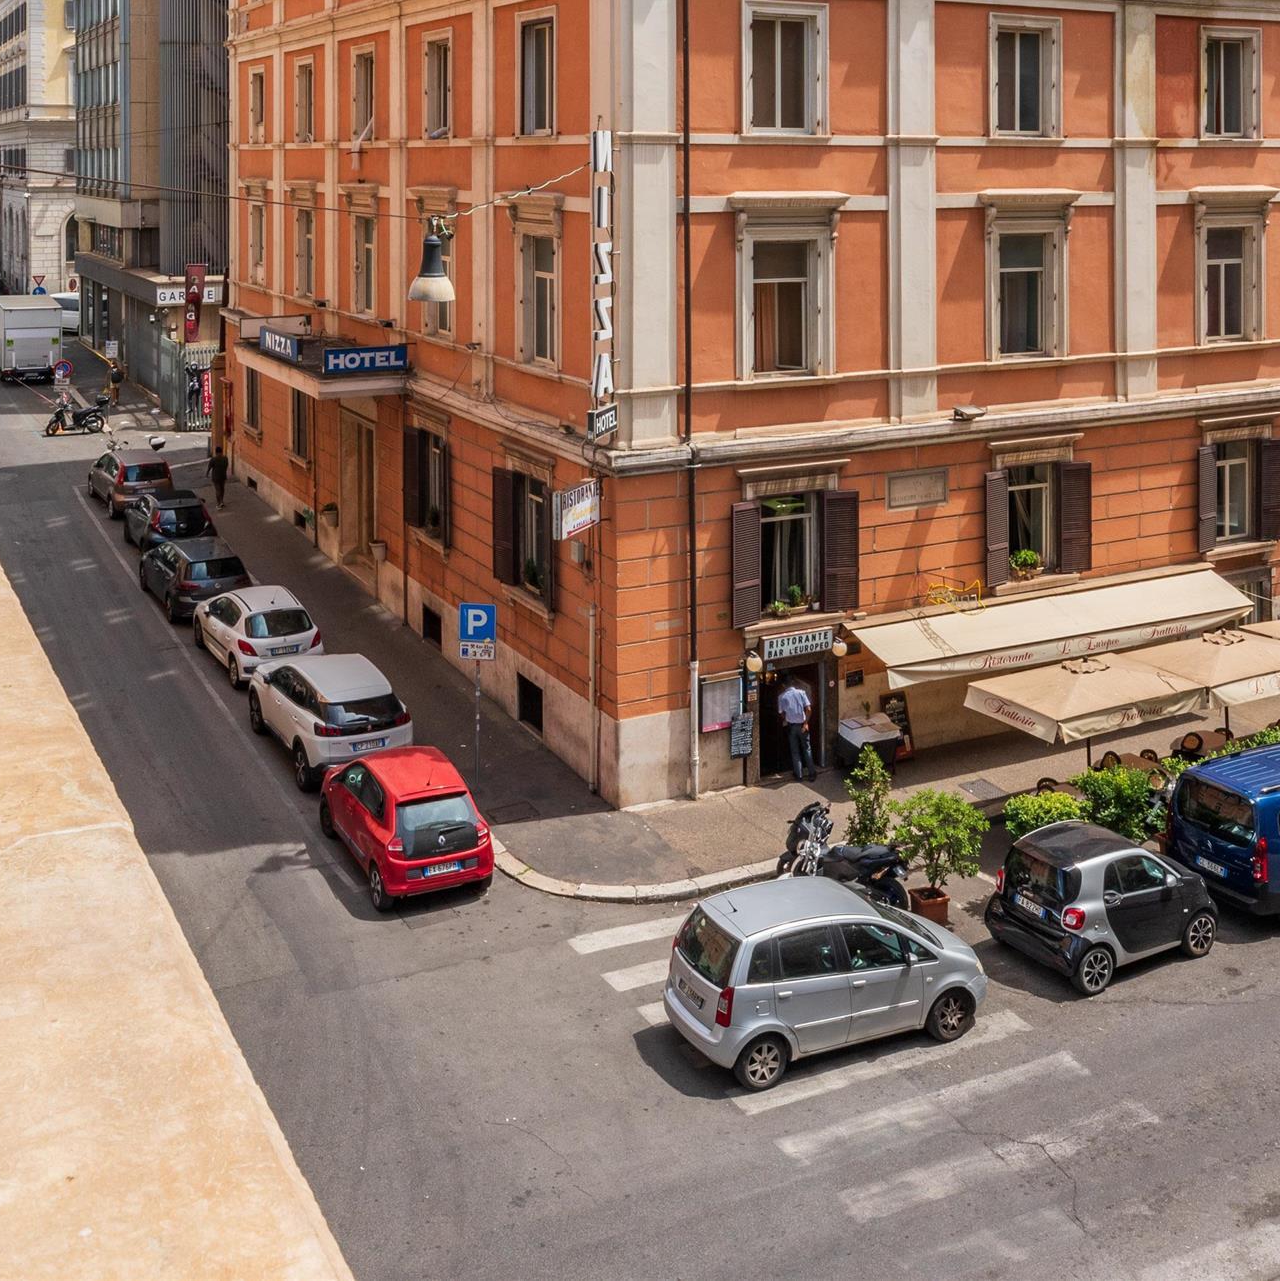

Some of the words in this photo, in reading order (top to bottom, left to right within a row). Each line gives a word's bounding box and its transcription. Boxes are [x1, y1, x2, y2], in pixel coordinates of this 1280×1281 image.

[158, 289, 215, 302] GARE
[265, 331, 293, 358] NIZZA
[328, 351, 404, 370] HOTEL
[203, 373, 211, 414] PARKING
[596, 409, 617, 436] HOTEL
[562, 481, 600, 510] RISTORANTE
[467, 609, 488, 636] P
[768, 648, 784, 659] BAR
[789, 641, 829, 656] L'EUROPEO
[769, 631, 829, 650] RISTORANTE
[970, 651, 1034, 670] Ristorante
[983, 694, 1037, 729] Trattoria
